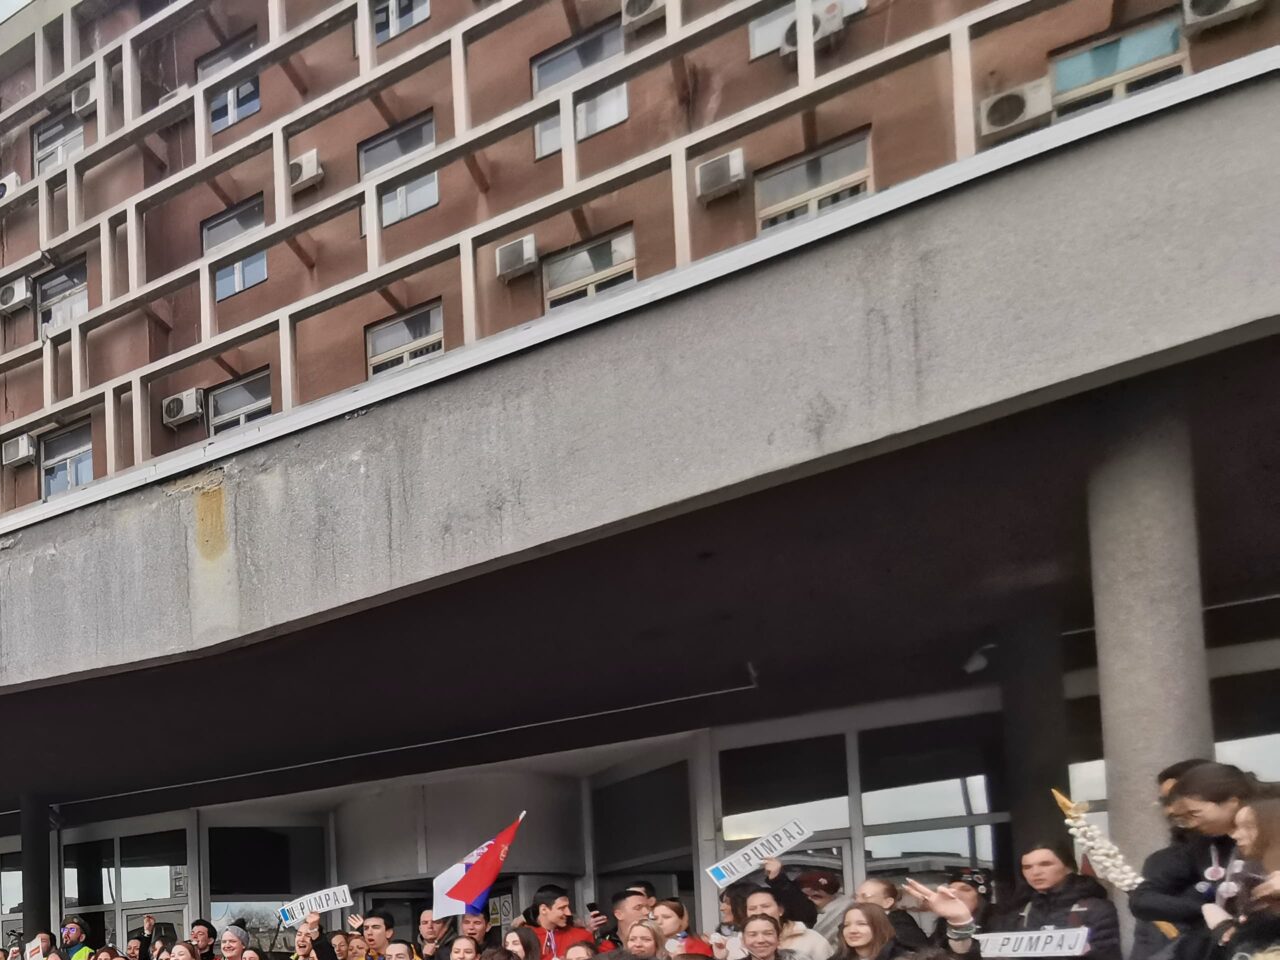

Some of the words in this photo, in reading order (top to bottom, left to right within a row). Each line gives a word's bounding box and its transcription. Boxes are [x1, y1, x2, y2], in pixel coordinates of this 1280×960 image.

[742, 821, 805, 867] PUMPAJ
[300, 889, 347, 916] PUMPAJ
[999, 933, 1081, 952] PUMPAJ
